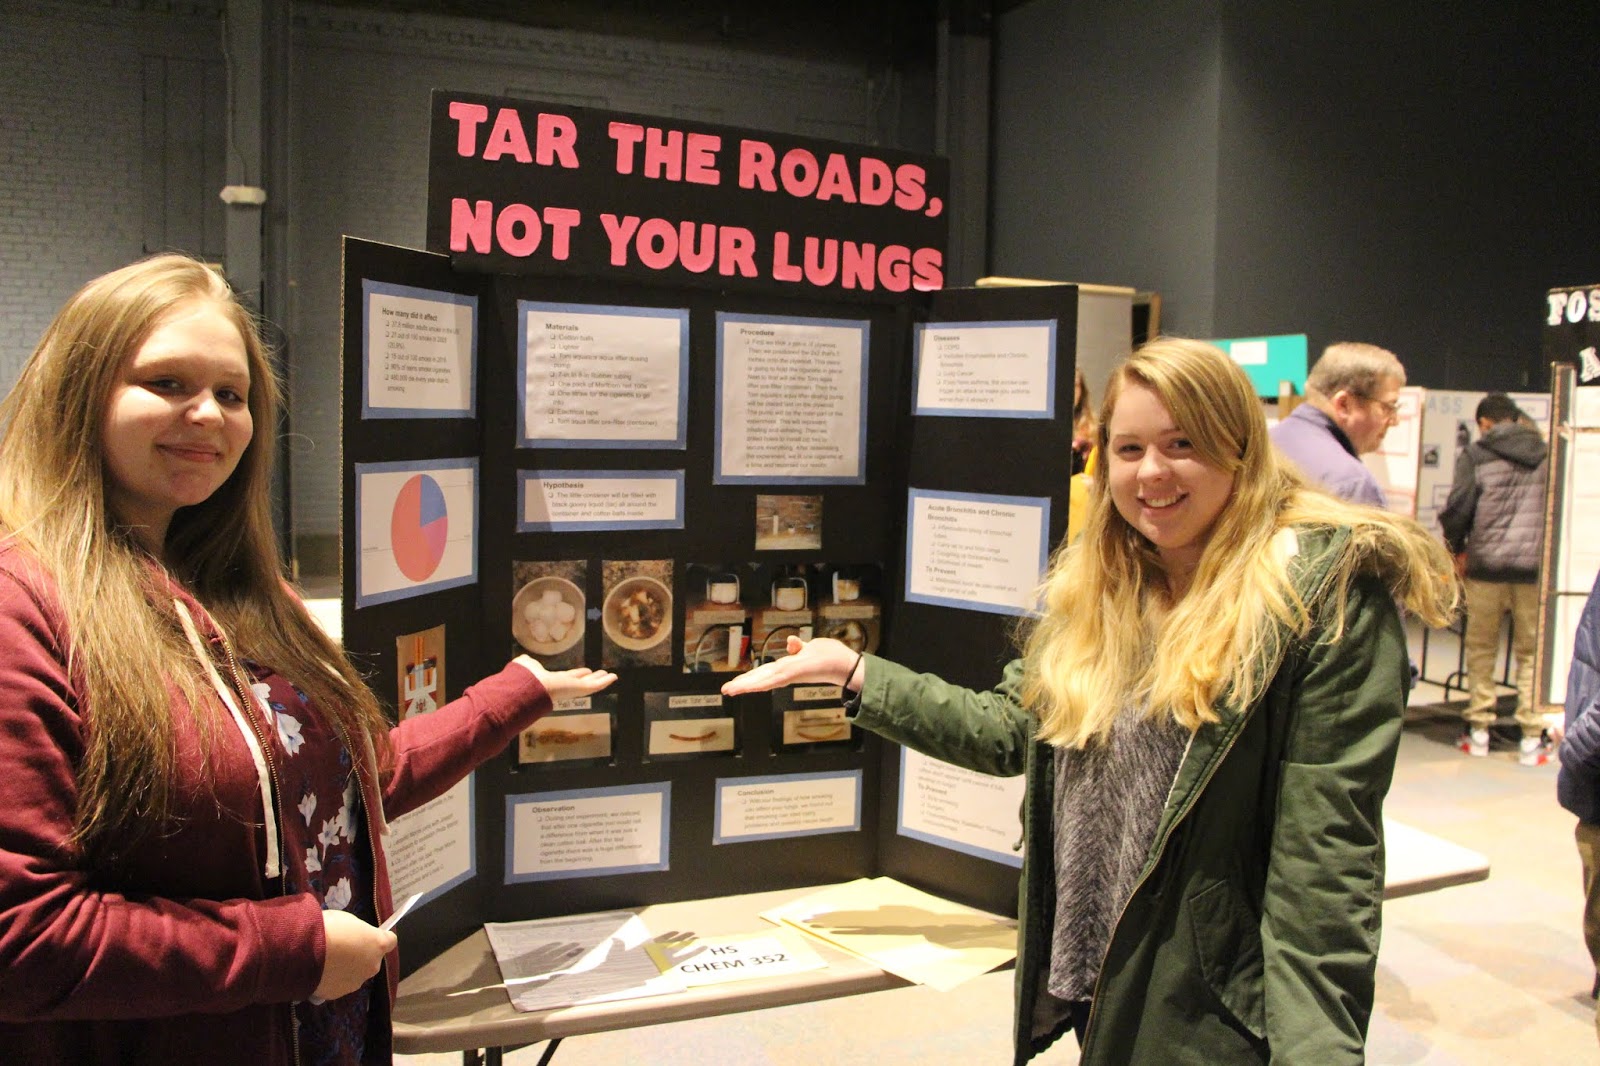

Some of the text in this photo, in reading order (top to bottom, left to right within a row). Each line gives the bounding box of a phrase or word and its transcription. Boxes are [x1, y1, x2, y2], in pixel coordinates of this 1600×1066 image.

[449, 101, 943, 218] TAR THE ROADS,
[450, 198, 945, 292] NOT YOUR LUNGS
[382, 308, 394, 316] How
[394, 311, 409, 320] many
[410, 311, 418, 319] did
[424, 313, 438, 321] affect
[934, 567, 956, 575] Prevent
[532, 805, 575, 813] Observation
[710, 946, 738, 955] HS
[680, 954, 788, 973] CHEM 352
